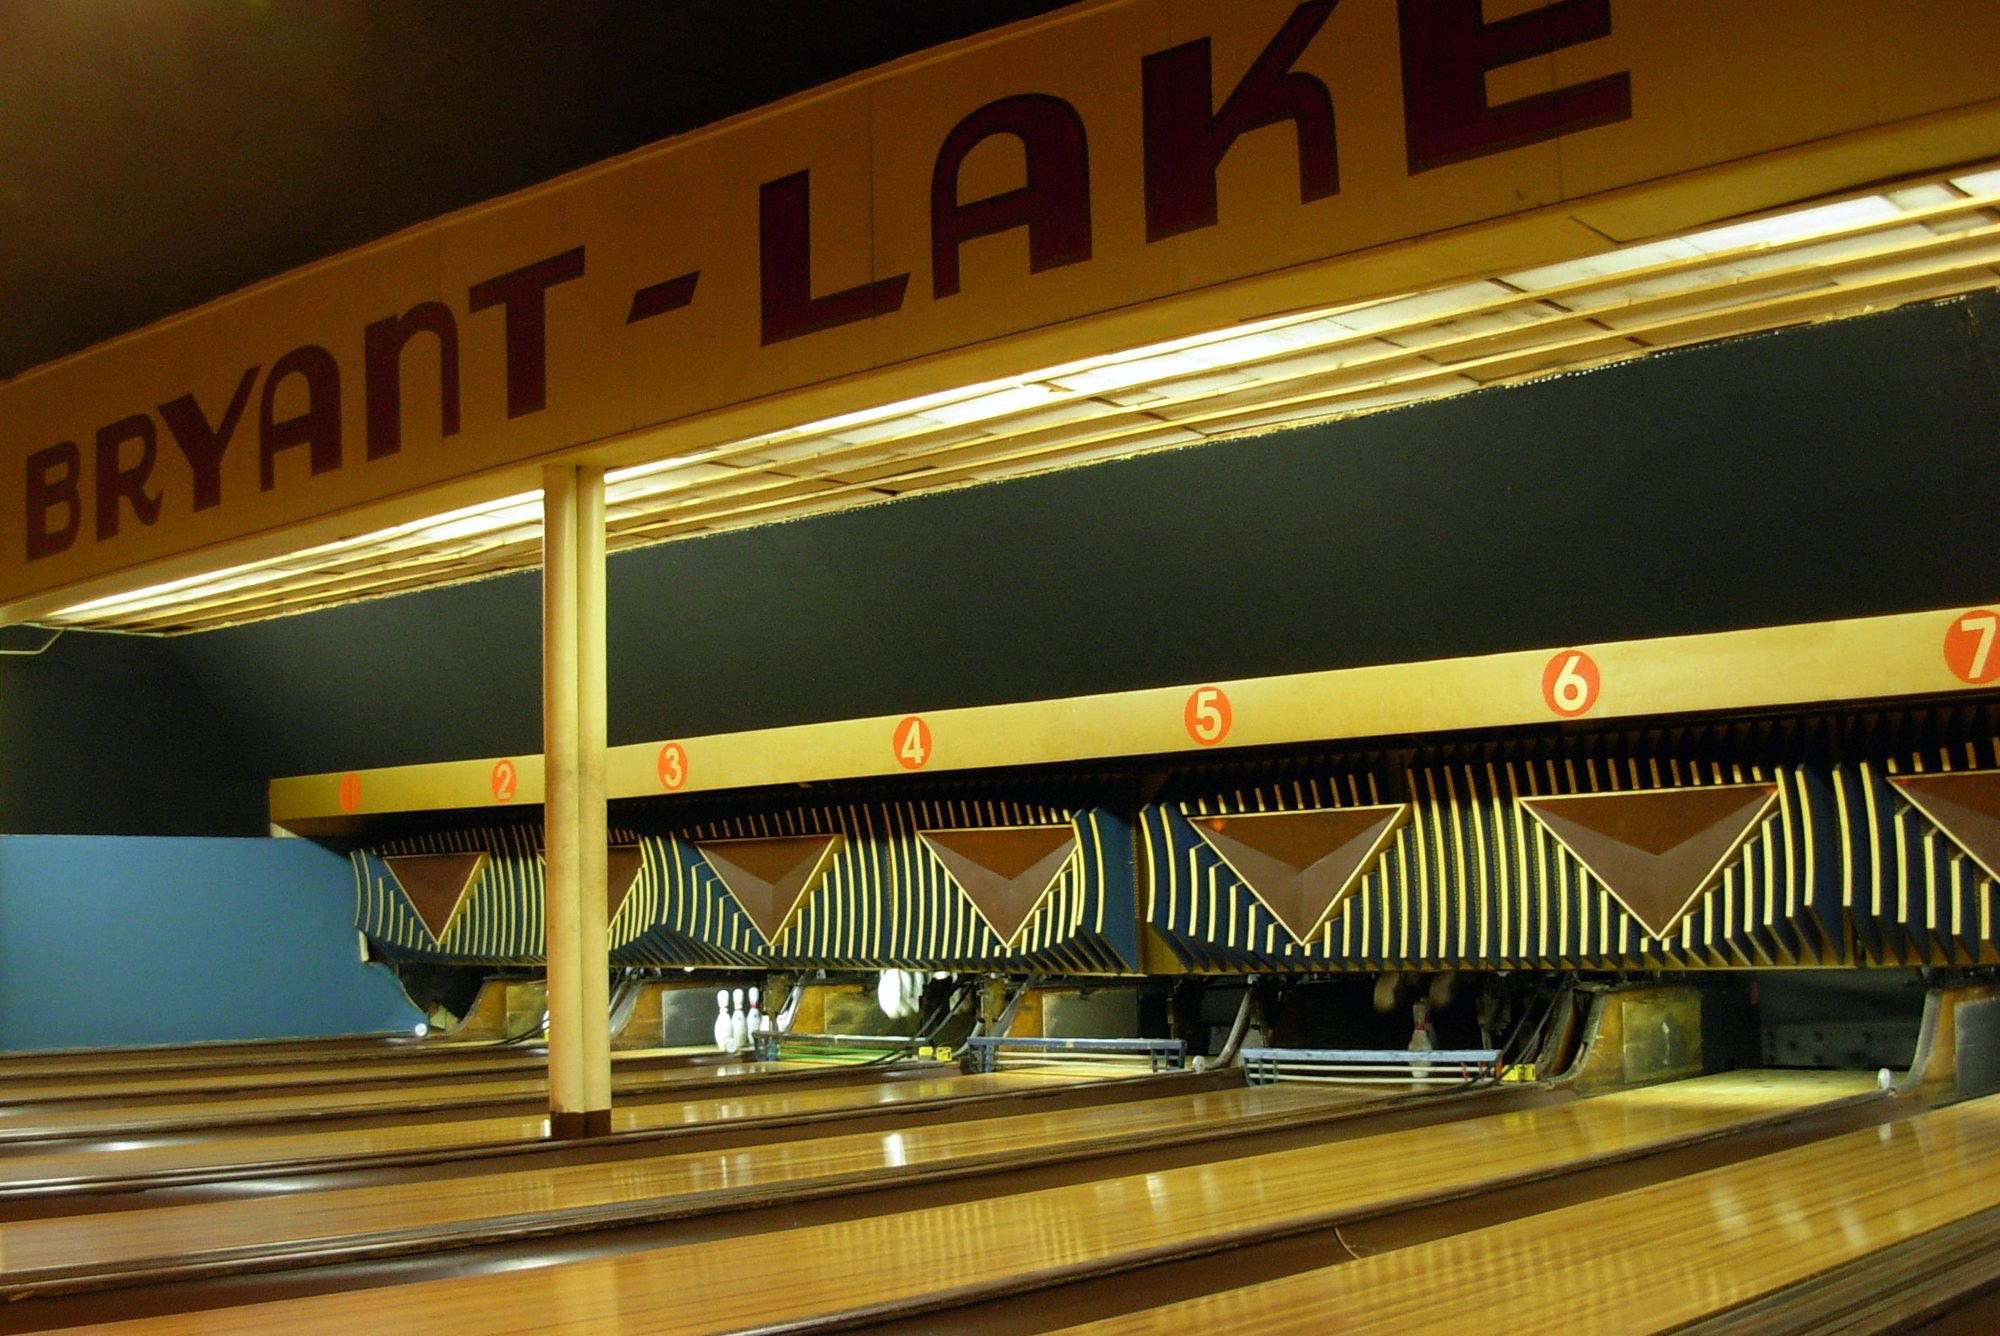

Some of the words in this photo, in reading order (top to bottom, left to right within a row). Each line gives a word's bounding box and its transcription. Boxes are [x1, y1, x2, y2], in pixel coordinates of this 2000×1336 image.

[1960, 615, 1998, 679] 7
[1552, 655, 1589, 713] 6
[1195, 692, 1224, 741] 5
[900, 719, 926, 764] 4
[496, 763, 513, 799] 2
[664, 746, 684, 788] 3
